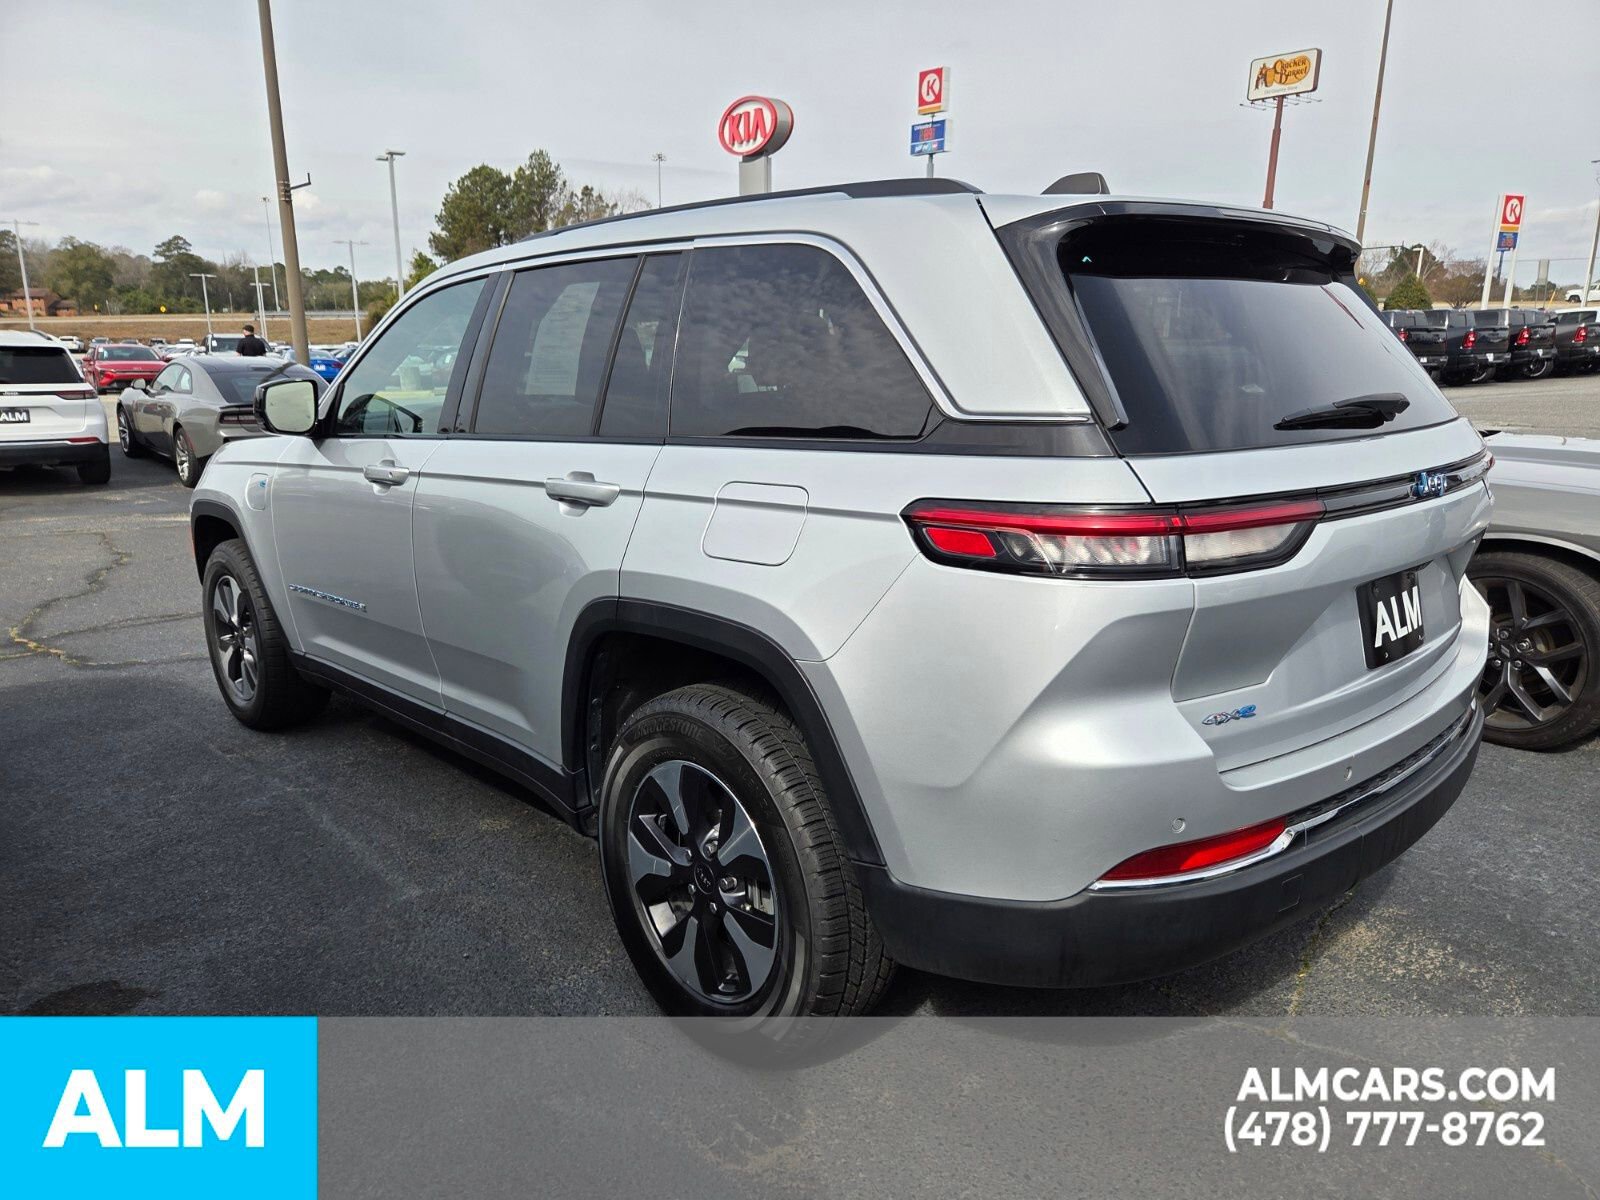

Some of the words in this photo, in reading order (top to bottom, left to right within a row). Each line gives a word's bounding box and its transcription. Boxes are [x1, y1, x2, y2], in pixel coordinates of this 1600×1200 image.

[926, 78, 938, 99] K
[727, 107, 767, 145] KIA
[0, 411, 27, 421] ALM
[1374, 585, 1422, 649] ALM
